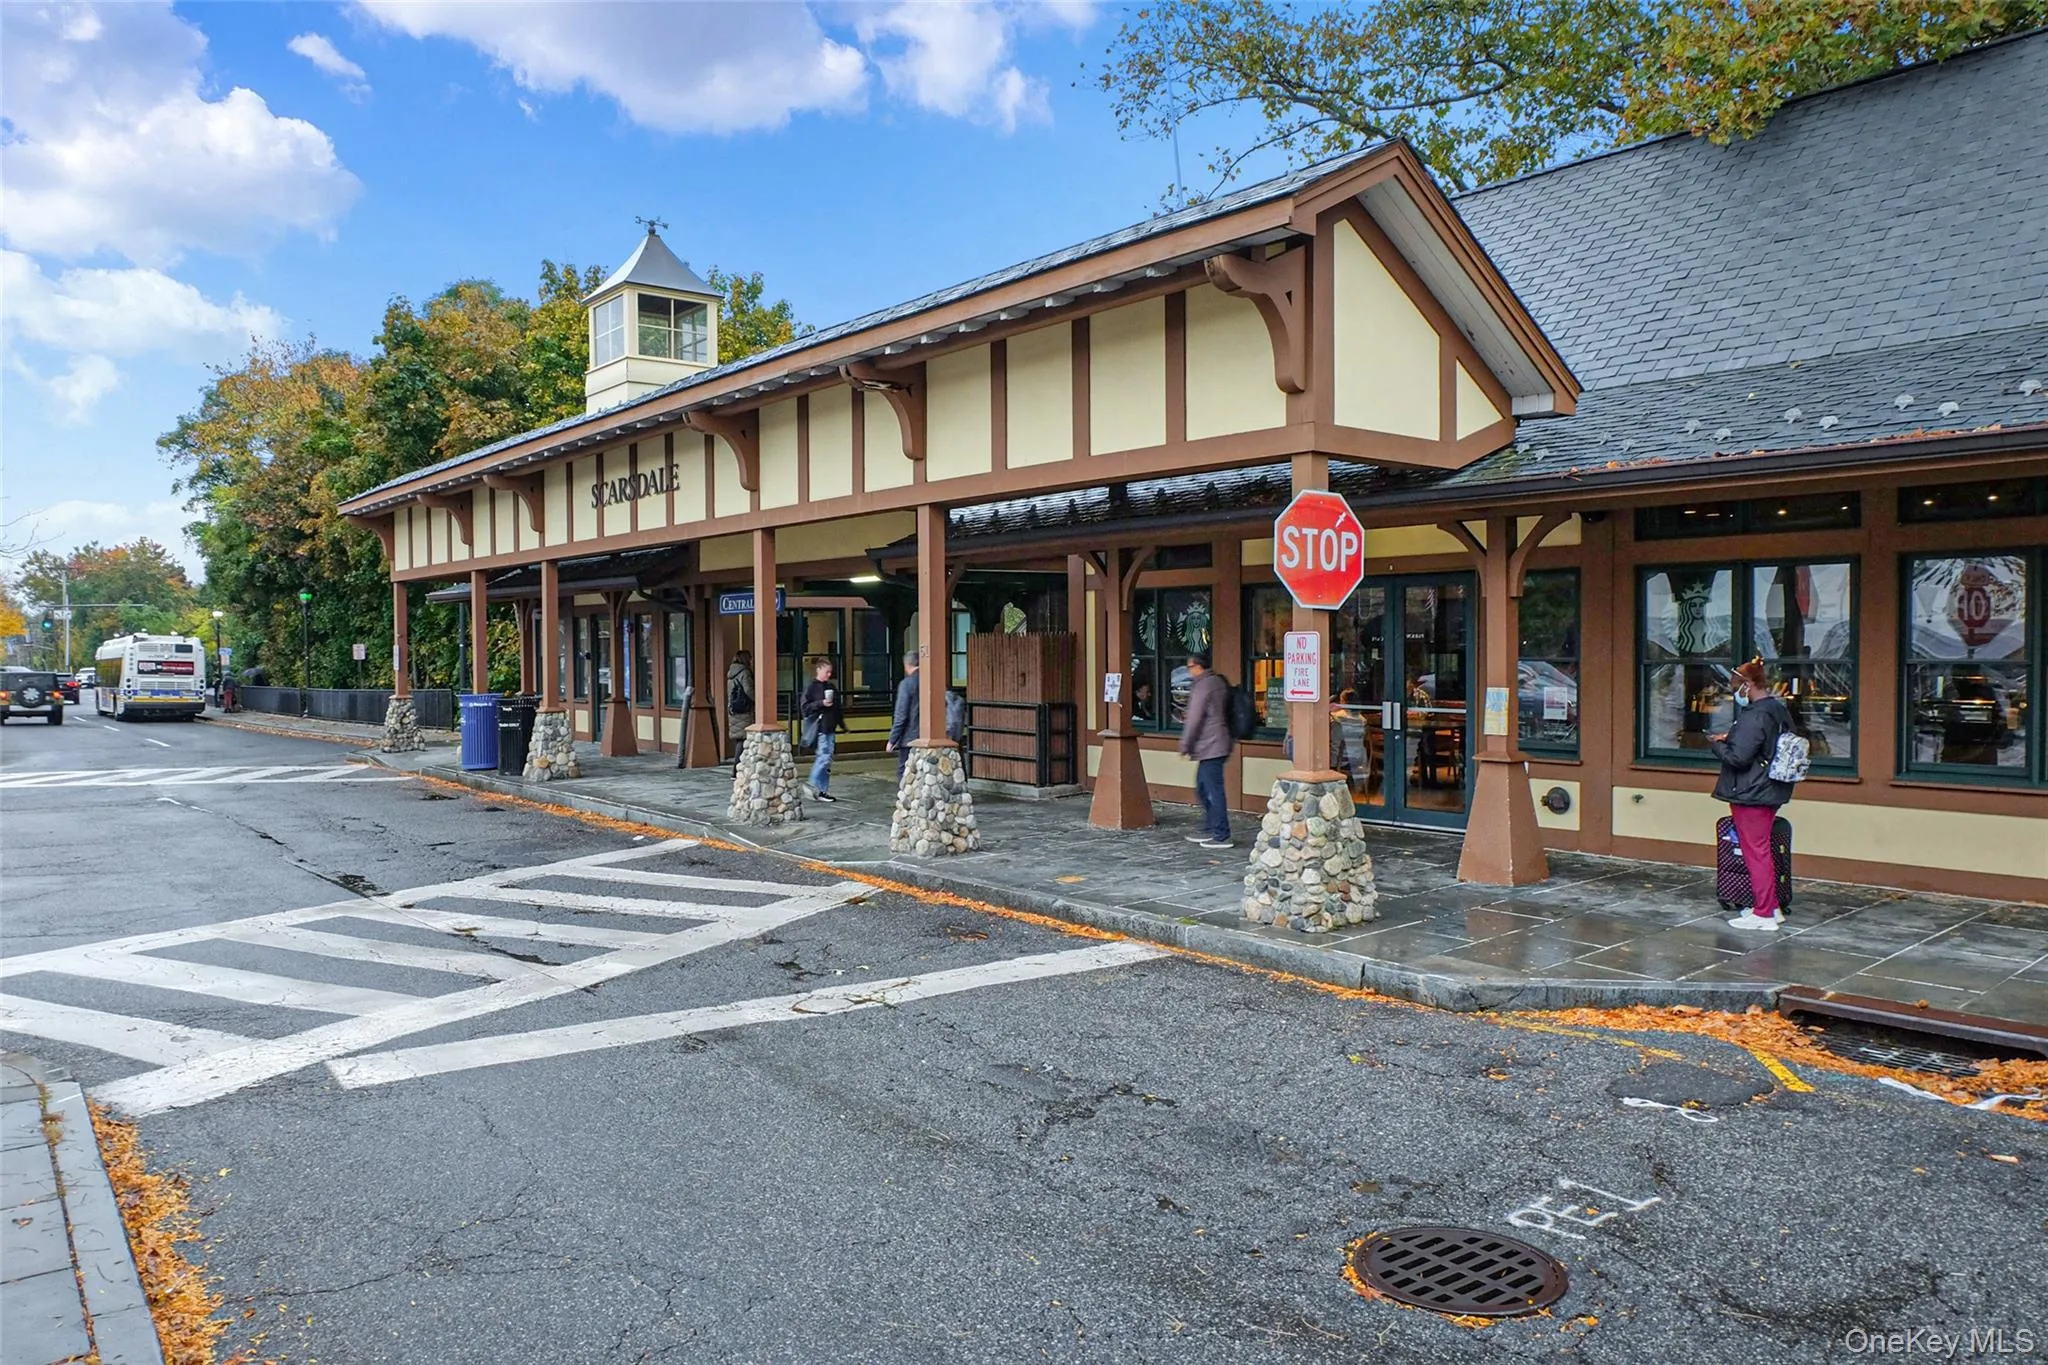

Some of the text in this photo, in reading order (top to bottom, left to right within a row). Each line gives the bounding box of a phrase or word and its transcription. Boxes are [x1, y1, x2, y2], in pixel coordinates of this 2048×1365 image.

[591, 463, 680, 508] SCARSDALE
[1281, 525, 1359, 572] STOP
[1296, 637, 1307, 650] NO
[1287, 652, 1317, 665] PARKING
[1294, 667, 1309, 677] FIRE
[1292, 678, 1310, 688] LANE
